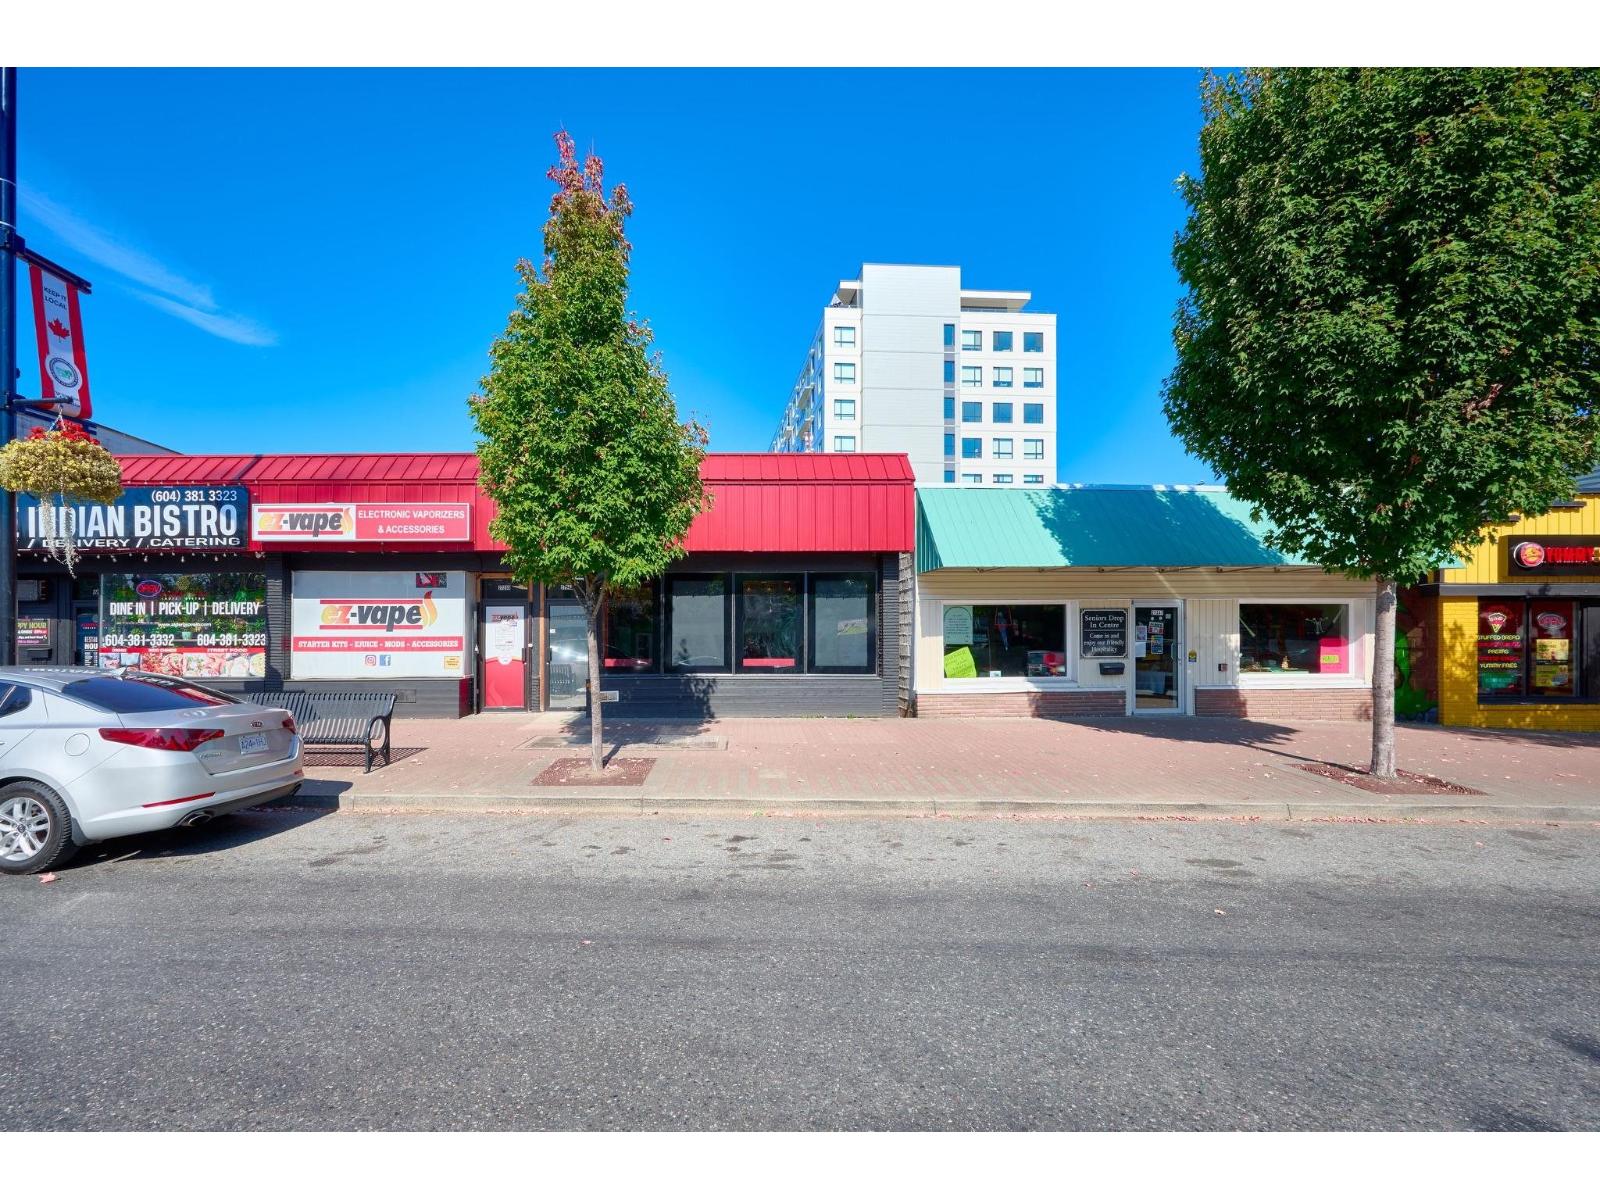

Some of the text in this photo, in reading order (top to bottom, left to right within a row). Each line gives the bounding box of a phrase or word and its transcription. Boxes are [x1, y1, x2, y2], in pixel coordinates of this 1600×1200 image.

[45, 295, 67, 311] LOCAL
[151, 489, 238, 503] (604) 381 3323
[134, 504, 238, 537] BISTRO
[358, 510, 465, 519] ELECTRONIC VAPORIZERS
[258, 513, 343, 537] ez-vape
[378, 525, 445, 534] & ACCESSORIES
[150, 537, 241, 547] CATERING
[110, 602, 133, 616] DINE
[135, 602, 146, 616] IN
[159, 602, 200, 616] PICK-UP
[212, 601, 260, 615] DELIVERY
[321, 605, 422, 632] ez-vape
[1084, 614, 1125, 623] Seniors Drop
[1098, 621, 1120, 629] Centre
[105, 633, 175, 647] 604-381-3332
[298, 641, 330, 649] STARTER
[411, 641, 459, 649] ACCESSORIES
